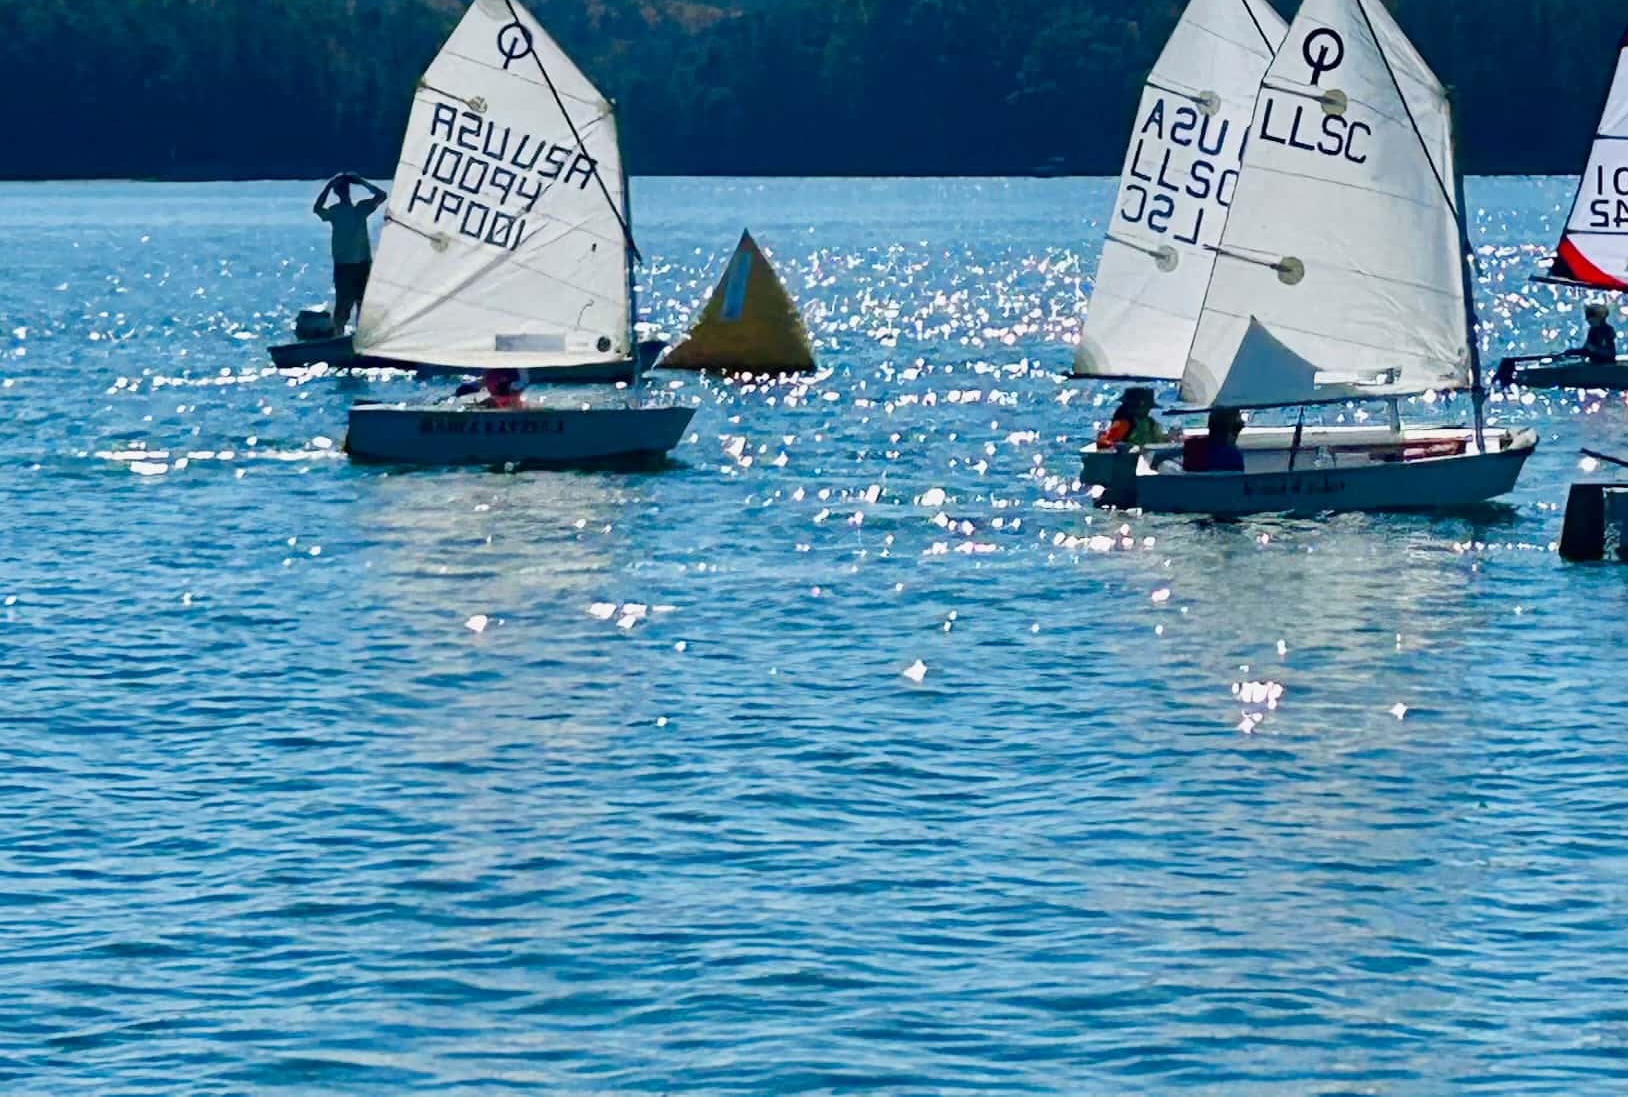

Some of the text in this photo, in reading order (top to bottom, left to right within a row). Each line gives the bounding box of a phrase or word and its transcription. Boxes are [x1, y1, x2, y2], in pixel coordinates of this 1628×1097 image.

[511, 134, 599, 190] USA
[1259, 98, 1372, 164] LLSC
[422, 142, 543, 213] 10094
